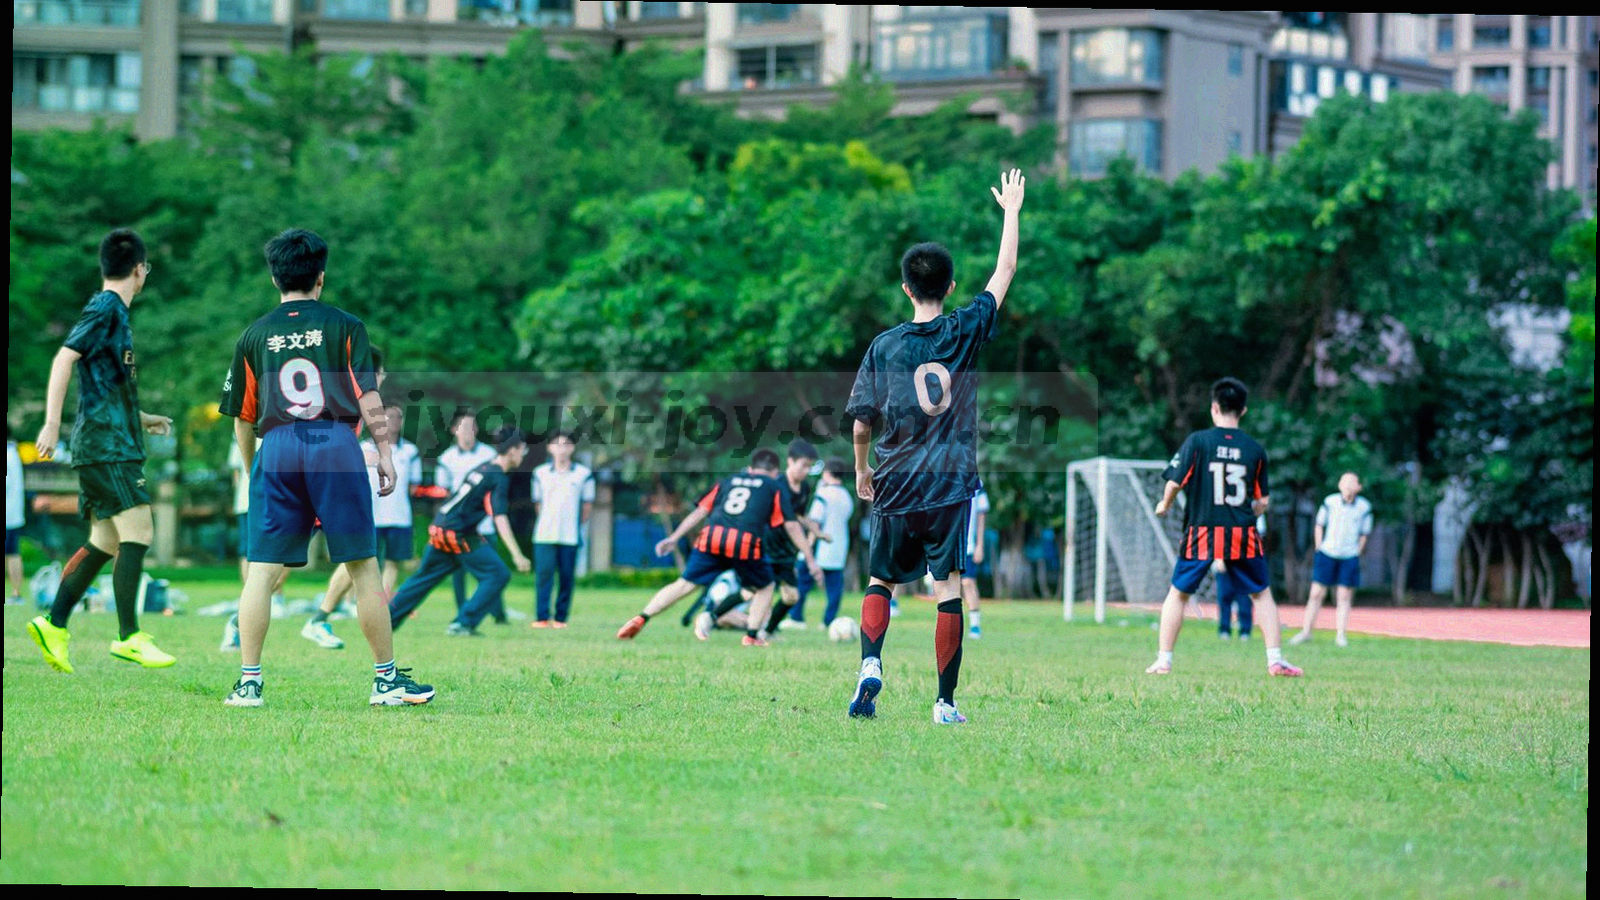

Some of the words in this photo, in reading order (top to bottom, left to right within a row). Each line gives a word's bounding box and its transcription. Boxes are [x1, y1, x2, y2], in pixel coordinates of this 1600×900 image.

[266, 329, 323, 353] 李文涛
[279, 357, 325, 420] 9
[914, 362, 952, 416] 0
[723, 486, 751, 515] 8
[1208, 462, 1247, 507] 13
